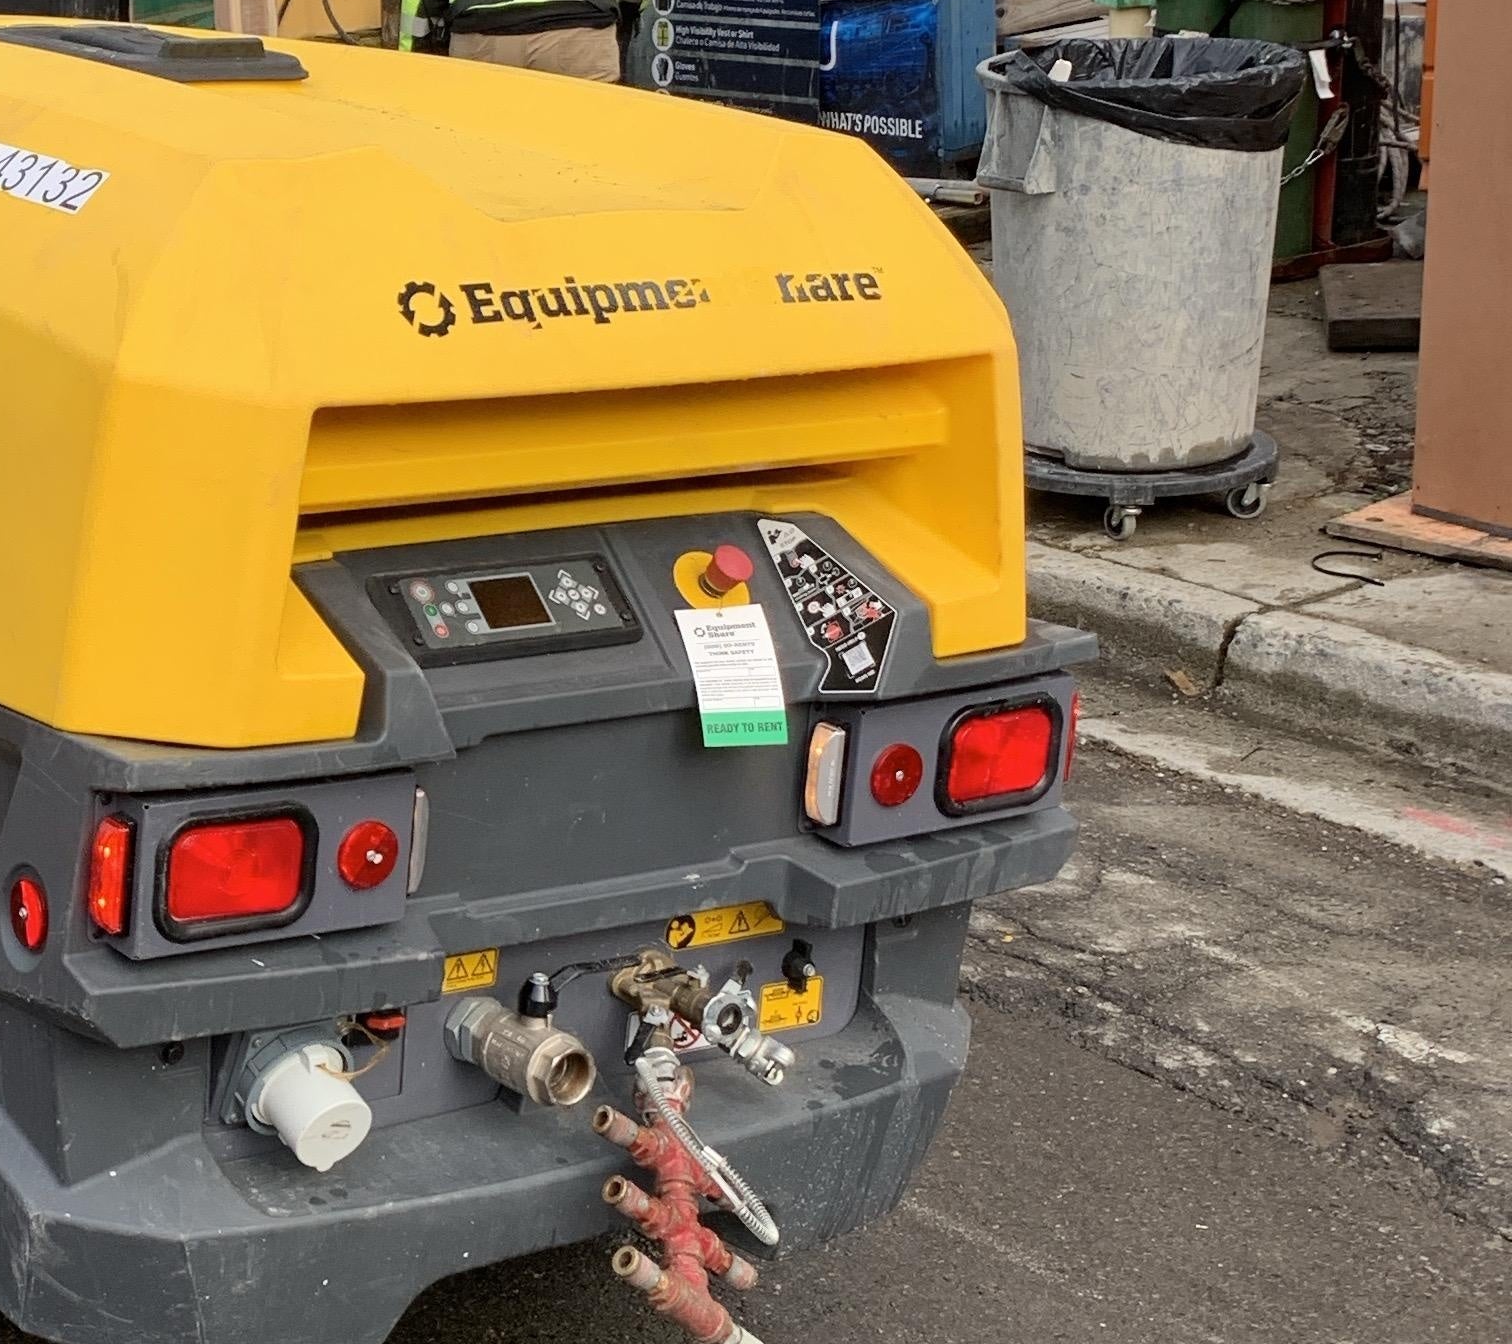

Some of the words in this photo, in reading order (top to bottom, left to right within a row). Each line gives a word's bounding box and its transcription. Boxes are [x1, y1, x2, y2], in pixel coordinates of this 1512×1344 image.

[818, 111, 863, 132] WHAT'S
[864, 115, 923, 138] POSSIBLE
[706, 622, 756, 632] Equipment
[708, 723, 740, 734] READY
[742, 722, 755, 733] TO
[757, 722, 783, 732] RENT
